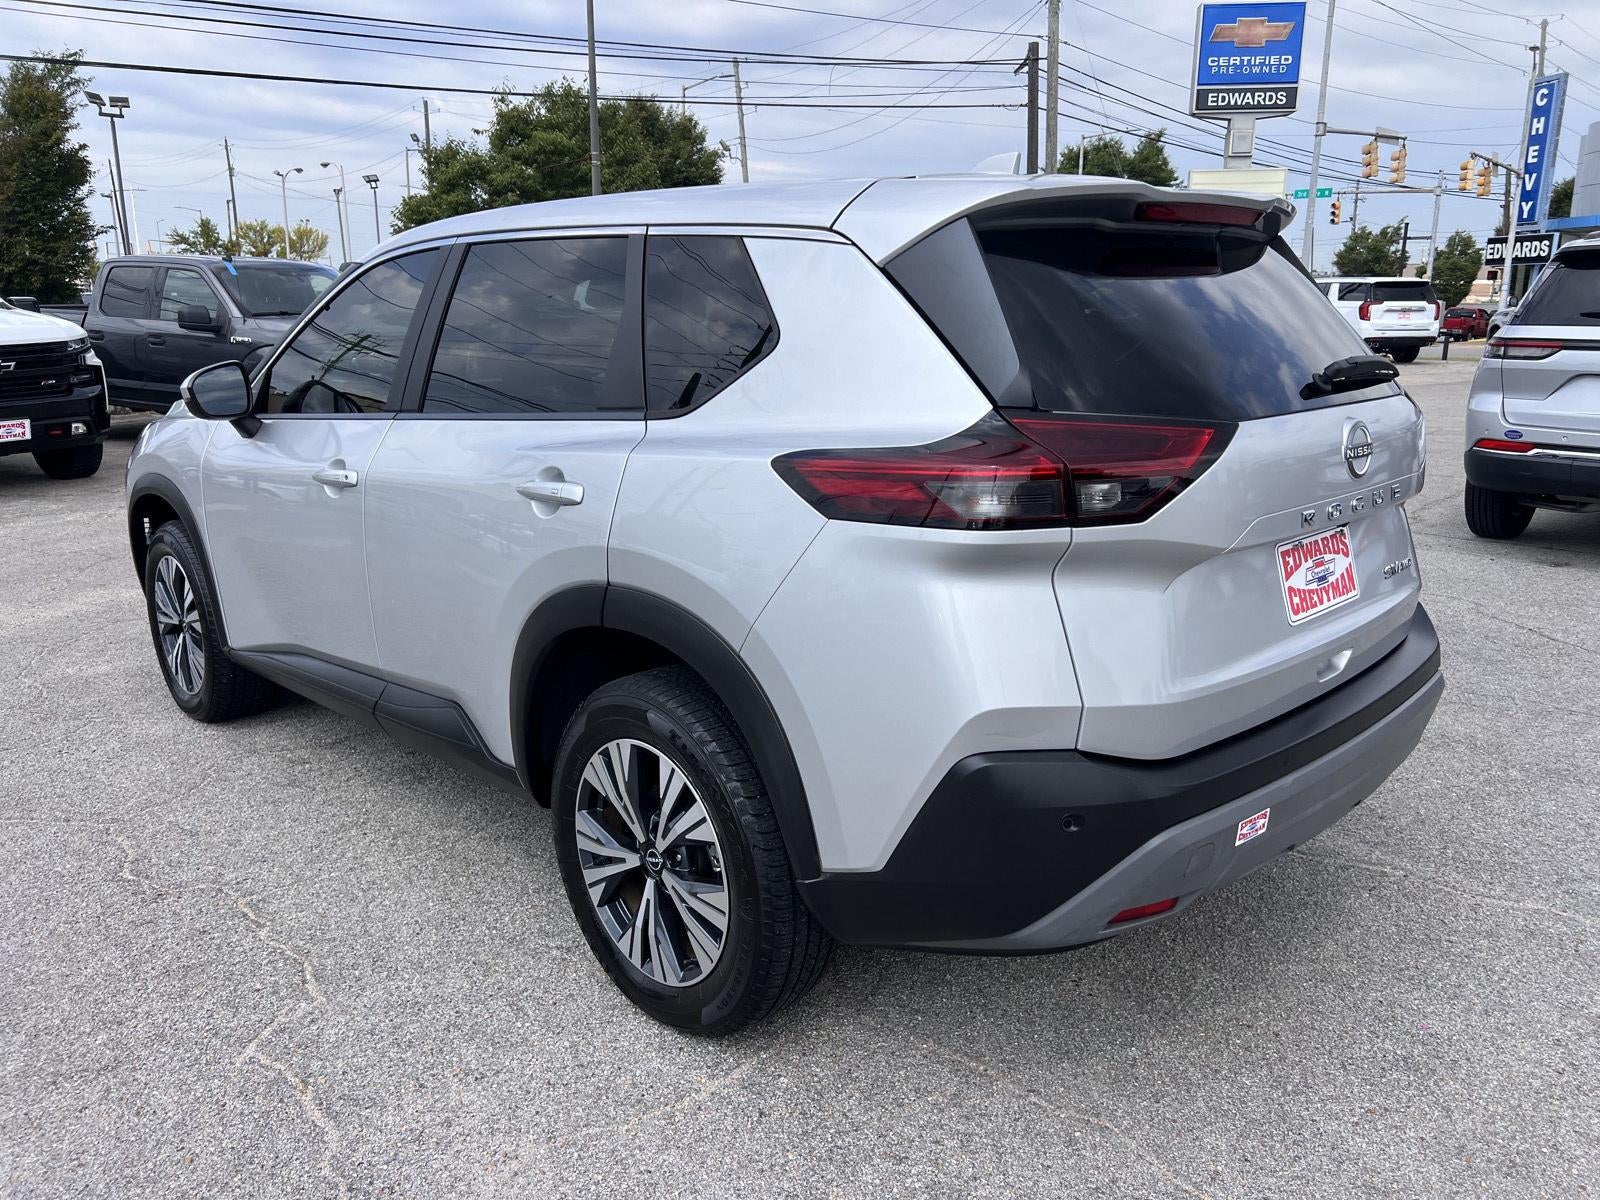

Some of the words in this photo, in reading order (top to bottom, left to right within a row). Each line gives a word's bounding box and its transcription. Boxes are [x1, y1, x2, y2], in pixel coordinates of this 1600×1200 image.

[1208, 55, 1293, 66] CERTIFIED
[1211, 65, 1287, 74] PRE-OWNED
[1207, 91, 1287, 106] EDWARDS
[1521, 88, 1549, 219] CHEVY
[1301, 483, 1401, 529] ROGUE
[1280, 532, 1350, 583] EDWARDS
[1287, 562, 1357, 616] CHEVYMAN
